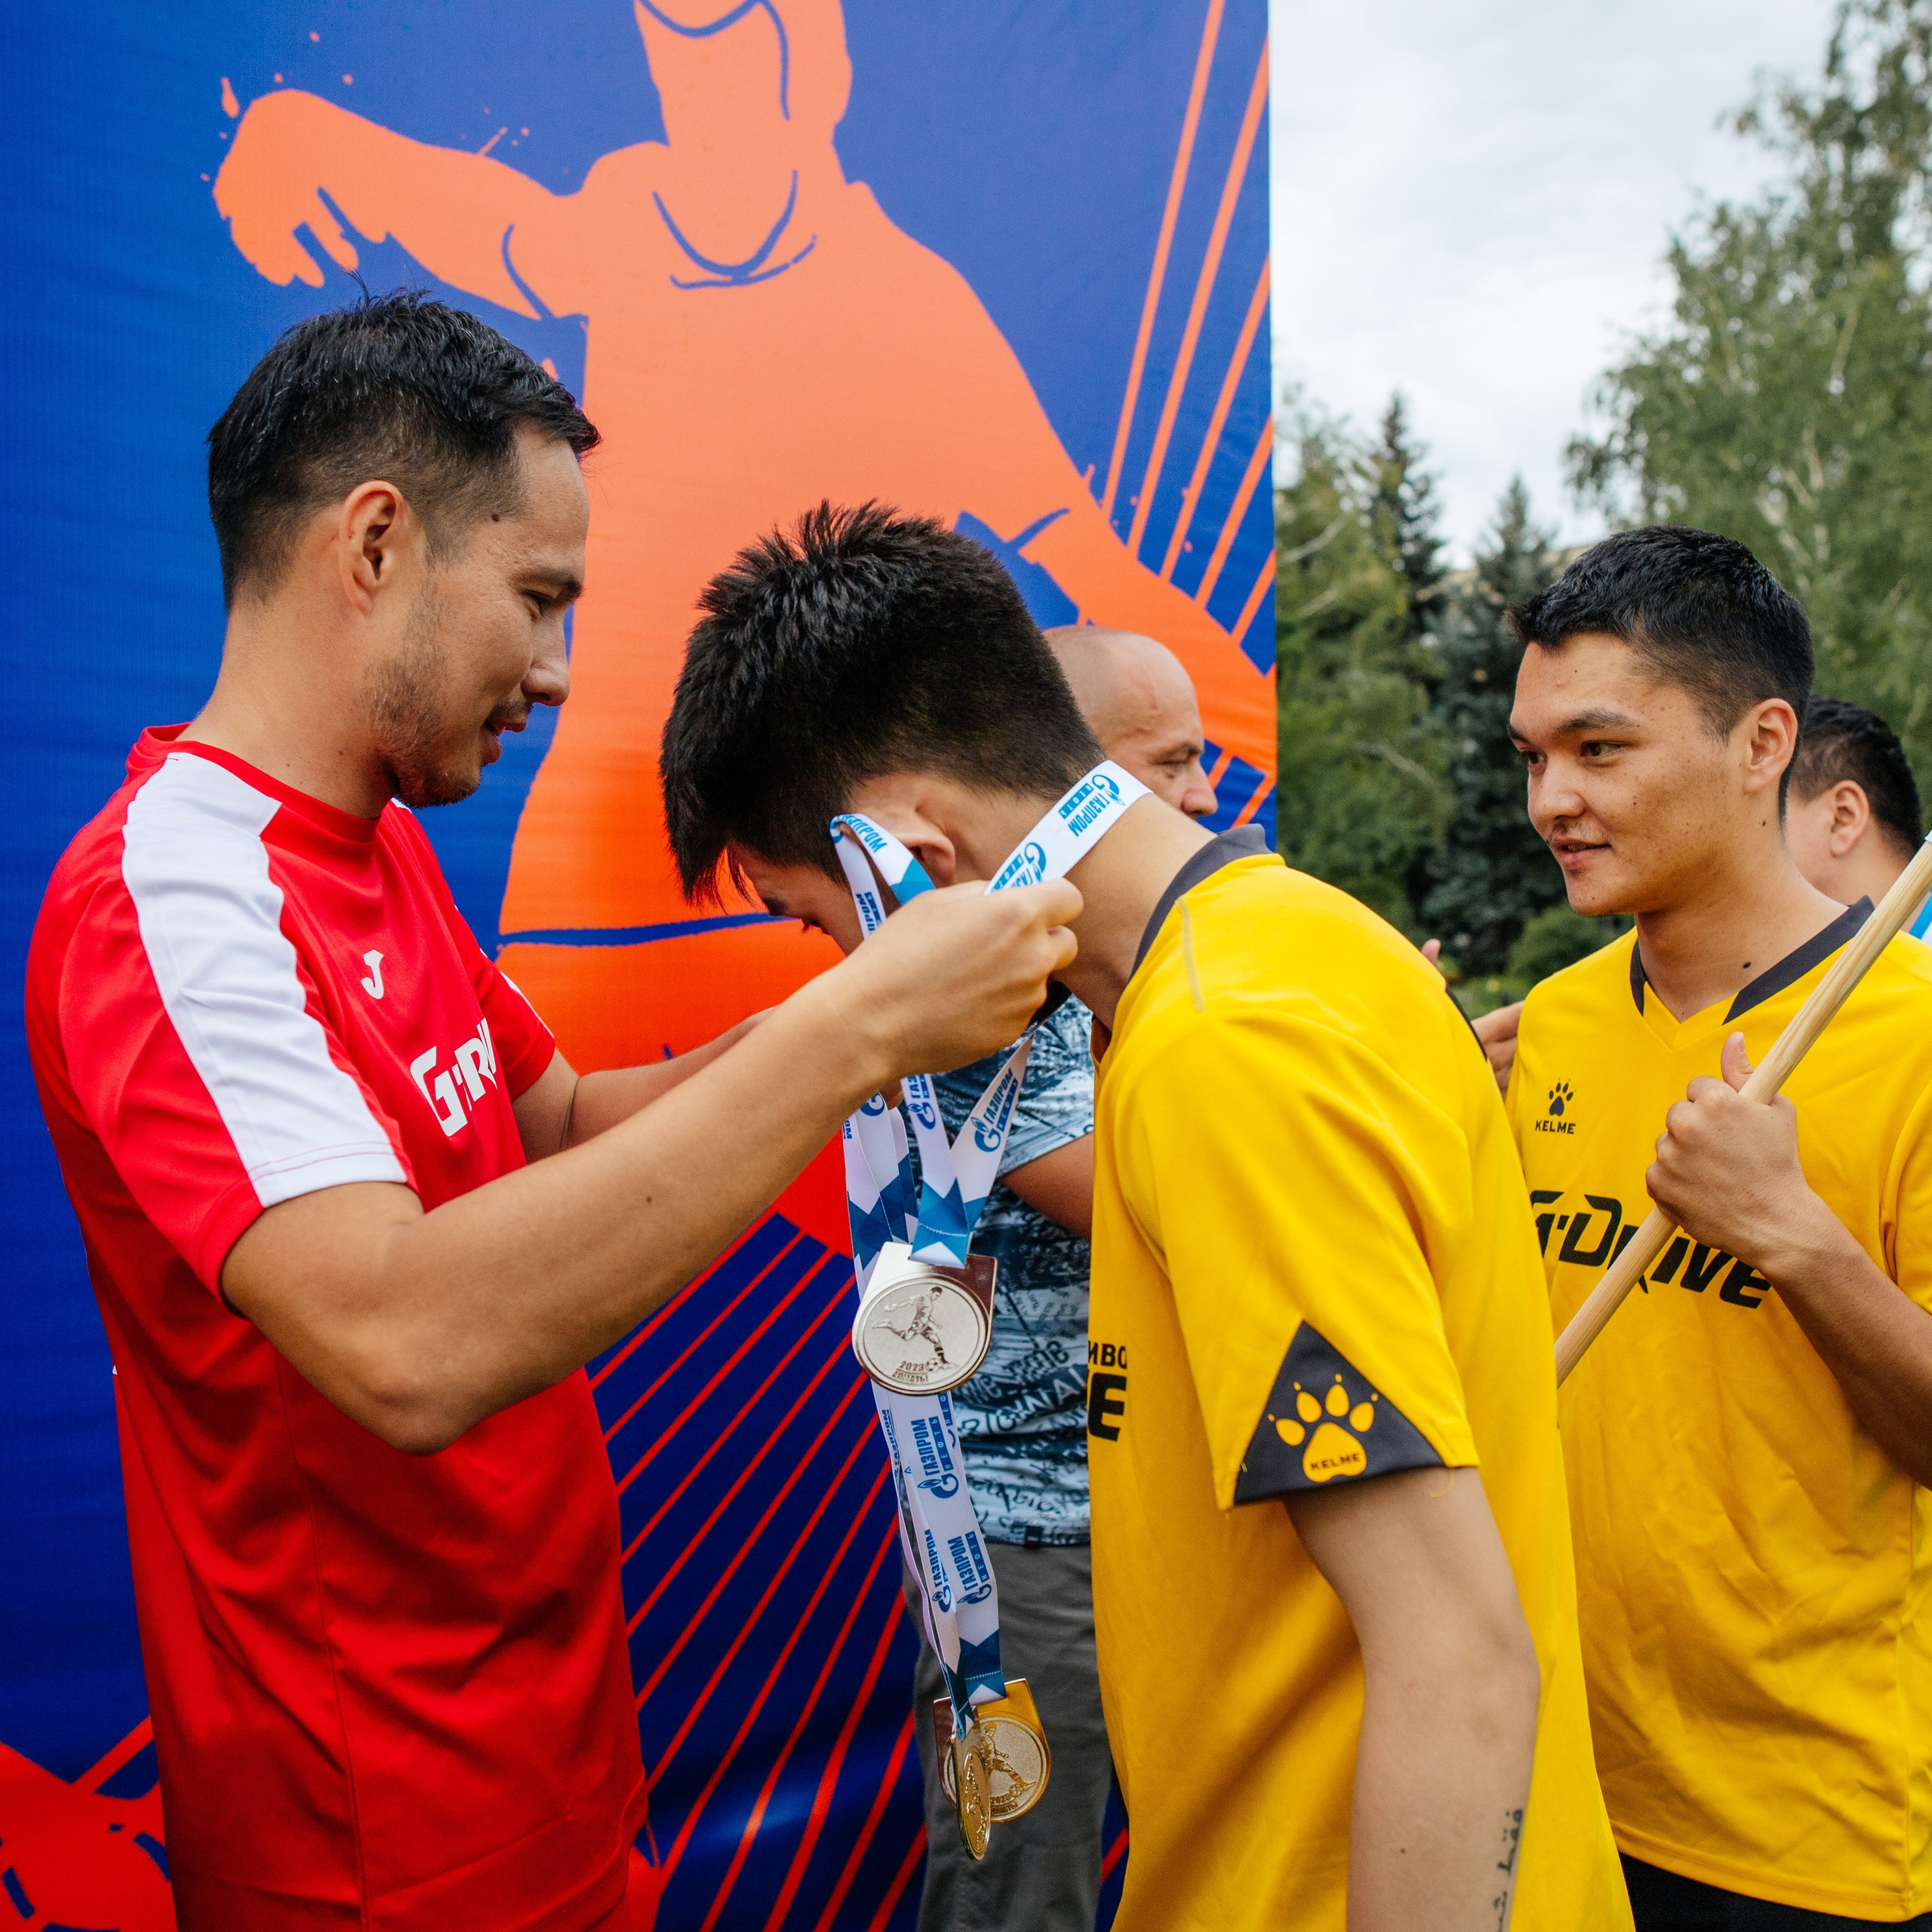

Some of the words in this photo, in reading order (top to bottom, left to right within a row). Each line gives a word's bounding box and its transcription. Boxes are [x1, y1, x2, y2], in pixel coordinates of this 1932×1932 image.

[1068, 792, 1110, 837] ГАЗПРОМ
[983, 1068, 1013, 1124] ГАЗПРОМ
[1535, 1120, 1577, 1134] KELME
[899, 1361, 924, 1371] 2023
[1088, 1340, 1127, 1369] ИВО
[939, 1394, 952, 1426] НЕФ
[911, 1418, 940, 1476] ГАЗПРОМ
[931, 1418, 952, 1470] НЕФТЬ
[1310, 1453, 1361, 1471] KELME
[924, 1529, 943, 1588] ГАЗПРОМ
[948, 1536, 979, 1592] ГАЗПРОМ
[968, 1531, 989, 1582] НЕФТЬ
